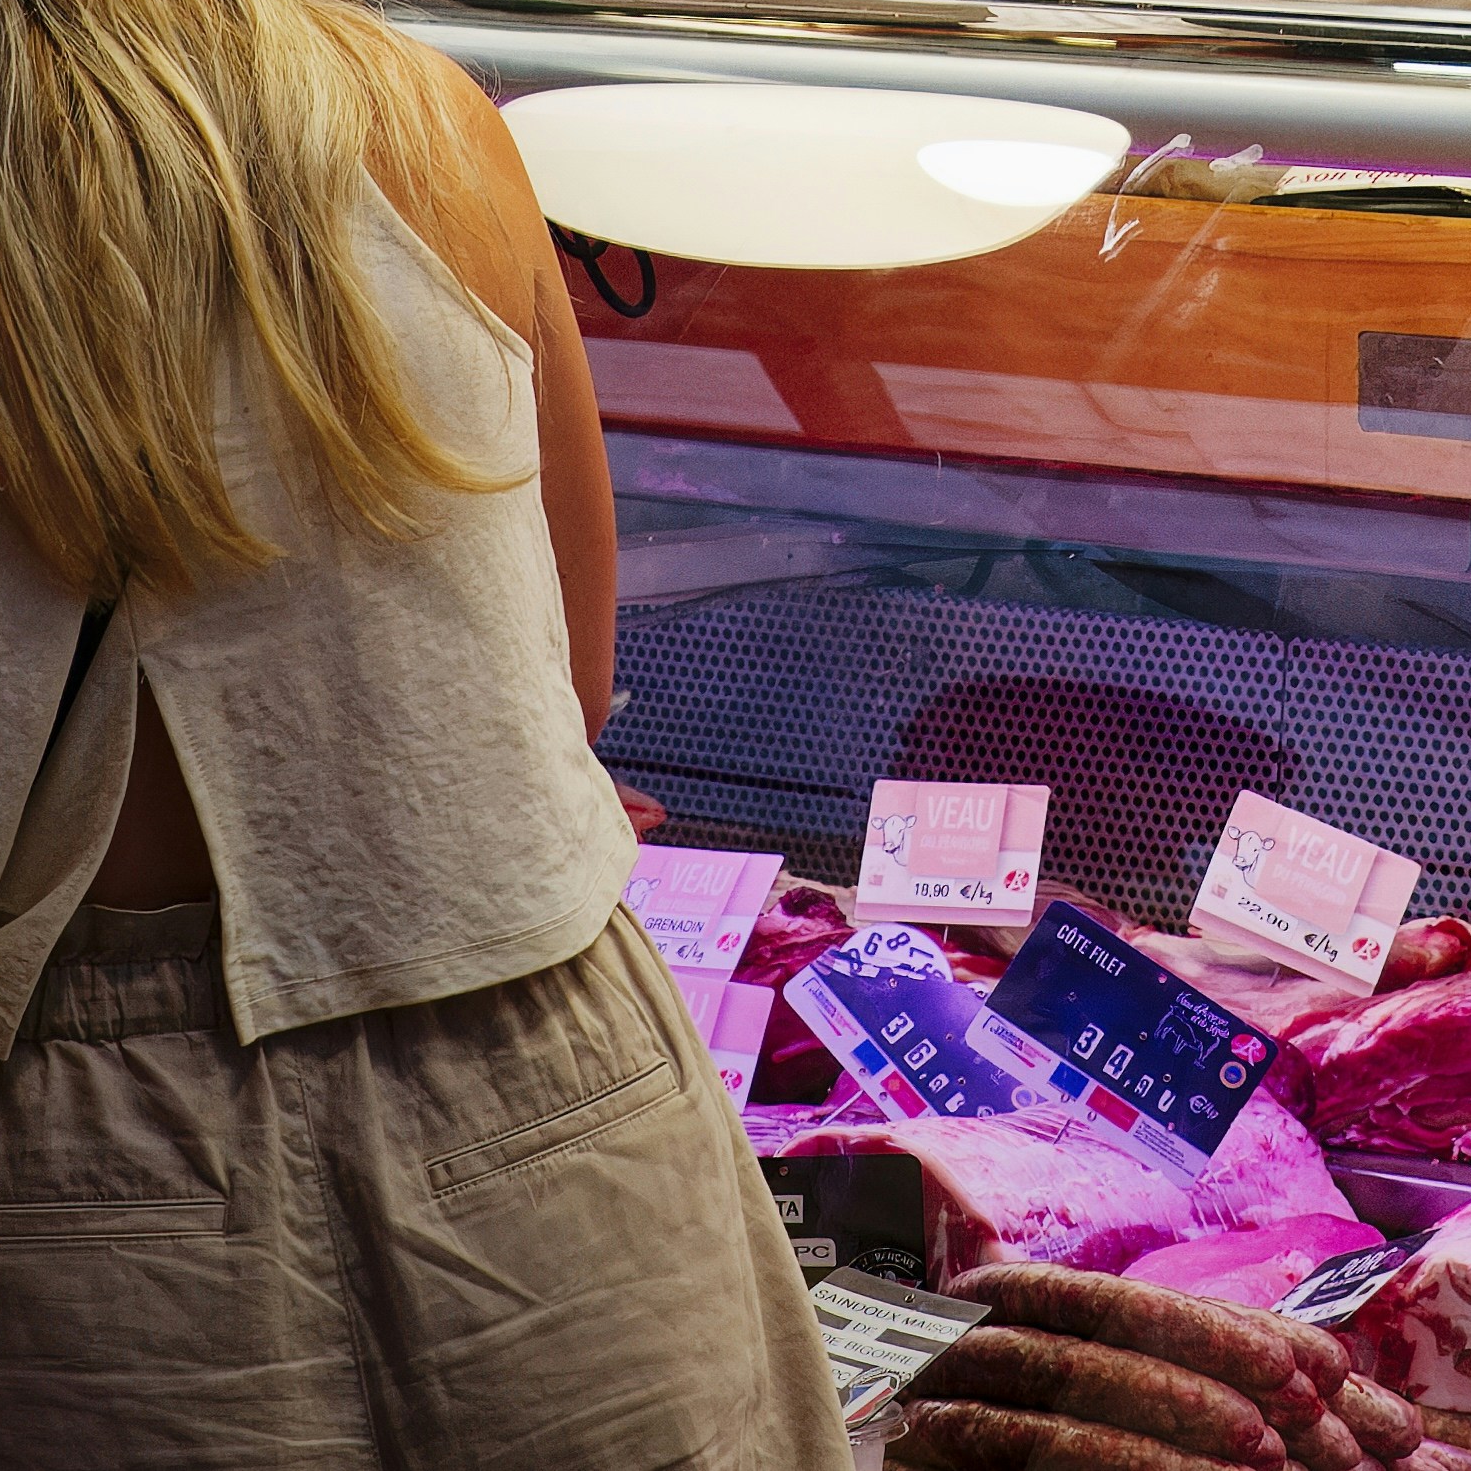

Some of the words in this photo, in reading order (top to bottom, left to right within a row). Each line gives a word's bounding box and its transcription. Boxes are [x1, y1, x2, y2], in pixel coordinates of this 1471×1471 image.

[928, 795, 996, 831] VEAU
[1286, 825, 1363, 886] VEAU
[669, 862, 733, 897] VEAU
[959, 881, 994, 905] €/kg
[644, 916, 705, 933] GRENADIN
[677, 941, 705, 963] €/kg
[1055, 924, 1087, 957] CÔTE
[1087, 946, 1127, 978] FILET
[1304, 933, 1339, 963] €/kg
[814, 1288, 902, 1324] SAINDOUX
[901, 1315, 963, 1338] MAISON
[852, 1321, 879, 1339] DE
[845, 1340, 919, 1367] BIGORRE
